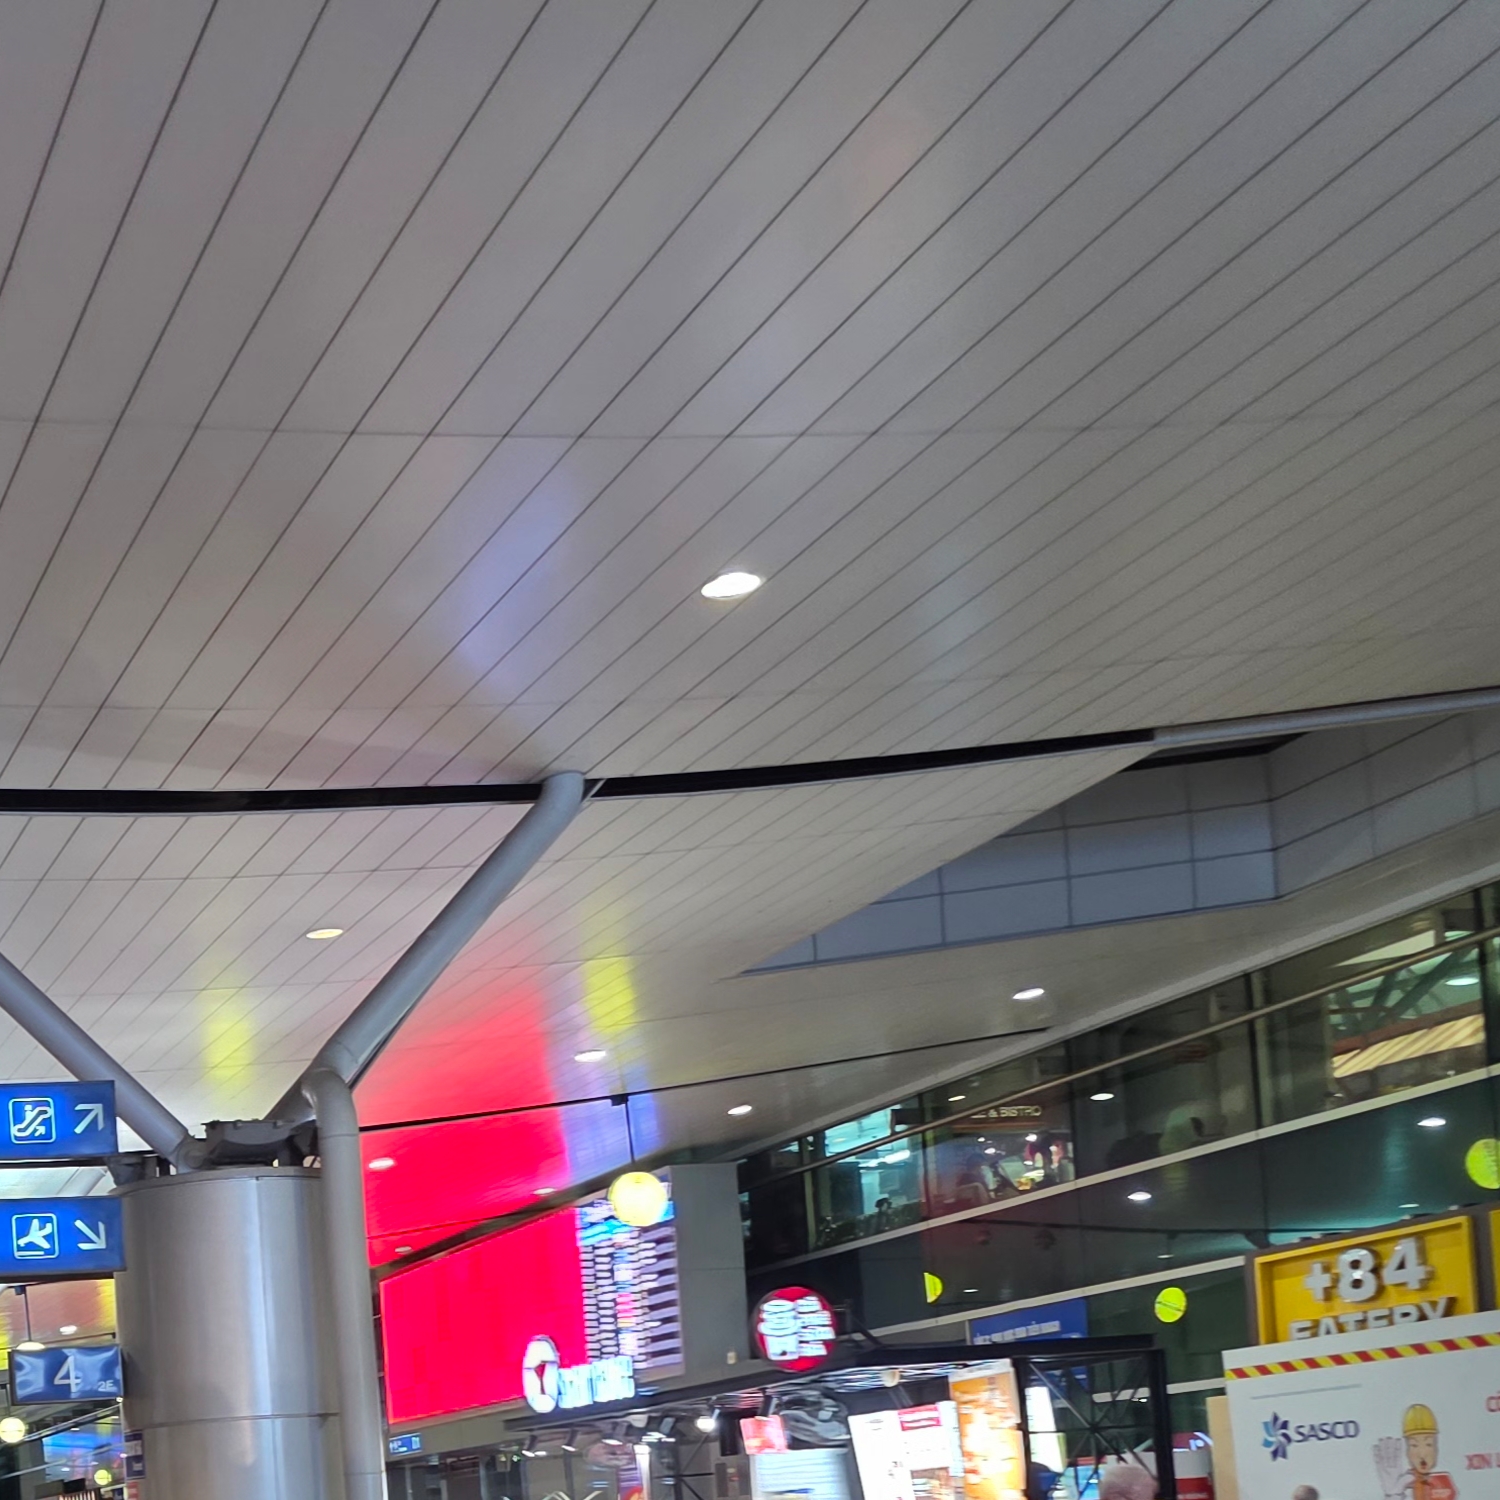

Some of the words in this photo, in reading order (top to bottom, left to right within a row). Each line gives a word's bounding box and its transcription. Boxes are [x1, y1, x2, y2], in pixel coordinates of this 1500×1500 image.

[1304, 1237, 1430, 1303] +84
[54, 1356, 82, 1392] 4
[1293, 1420, 1360, 1443] SASCO
